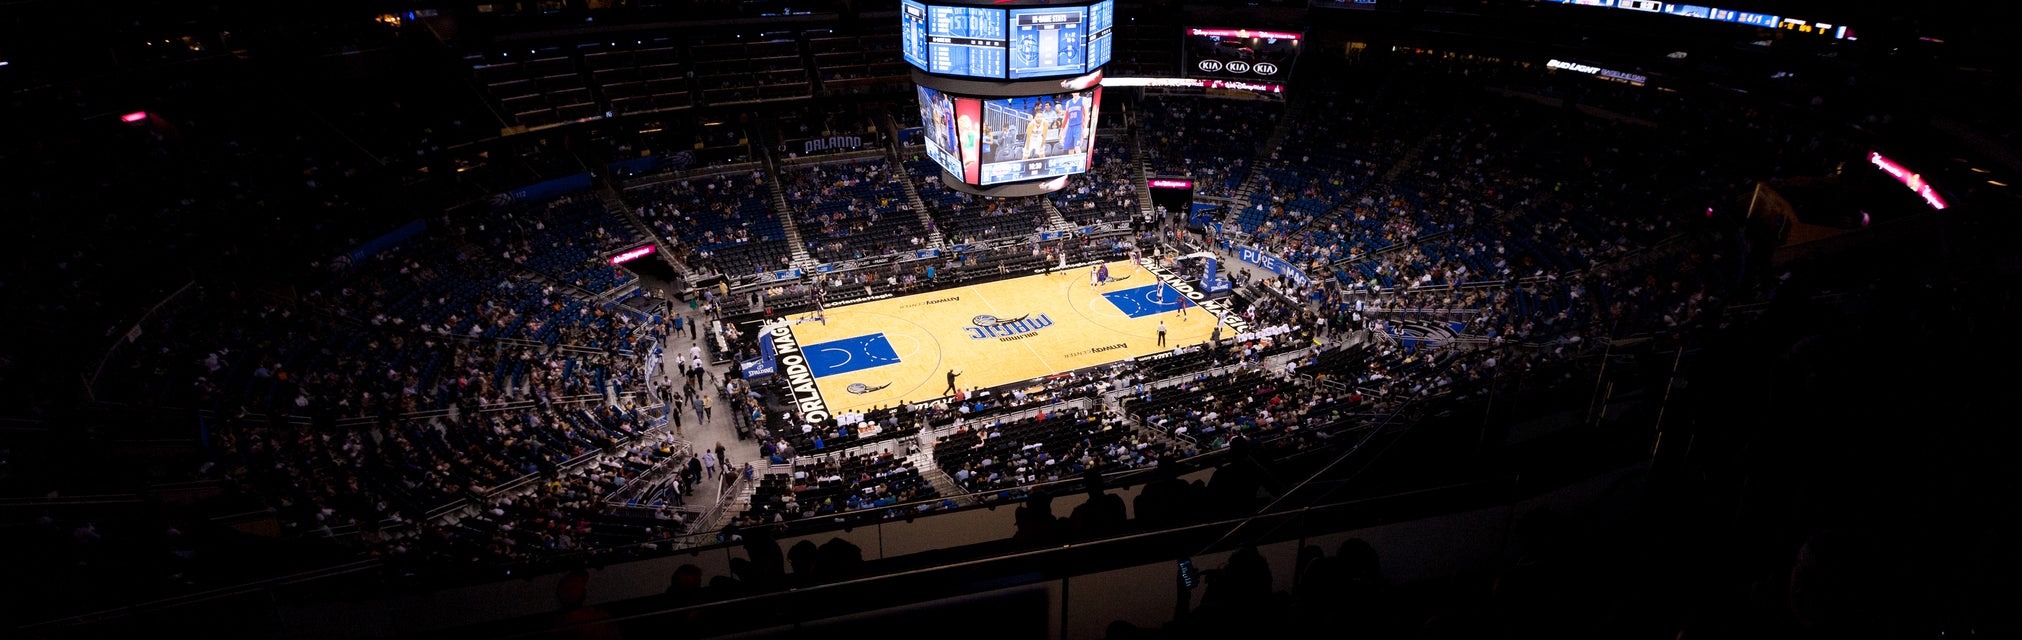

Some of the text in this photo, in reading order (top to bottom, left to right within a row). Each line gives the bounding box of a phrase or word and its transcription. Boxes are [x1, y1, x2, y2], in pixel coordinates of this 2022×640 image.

[805, 136, 861, 153] ORLANDO
[1243, 249, 1275, 270] PURE
[1139, 257, 1204, 300] ORLANDO
[926, 296, 960, 306] Amway
[963, 312, 1054, 340] MAGIC
[999, 331, 1039, 343] ORLANDO
[1091, 342, 1129, 354] Amway
[782, 355, 829, 424] ORLANDO
